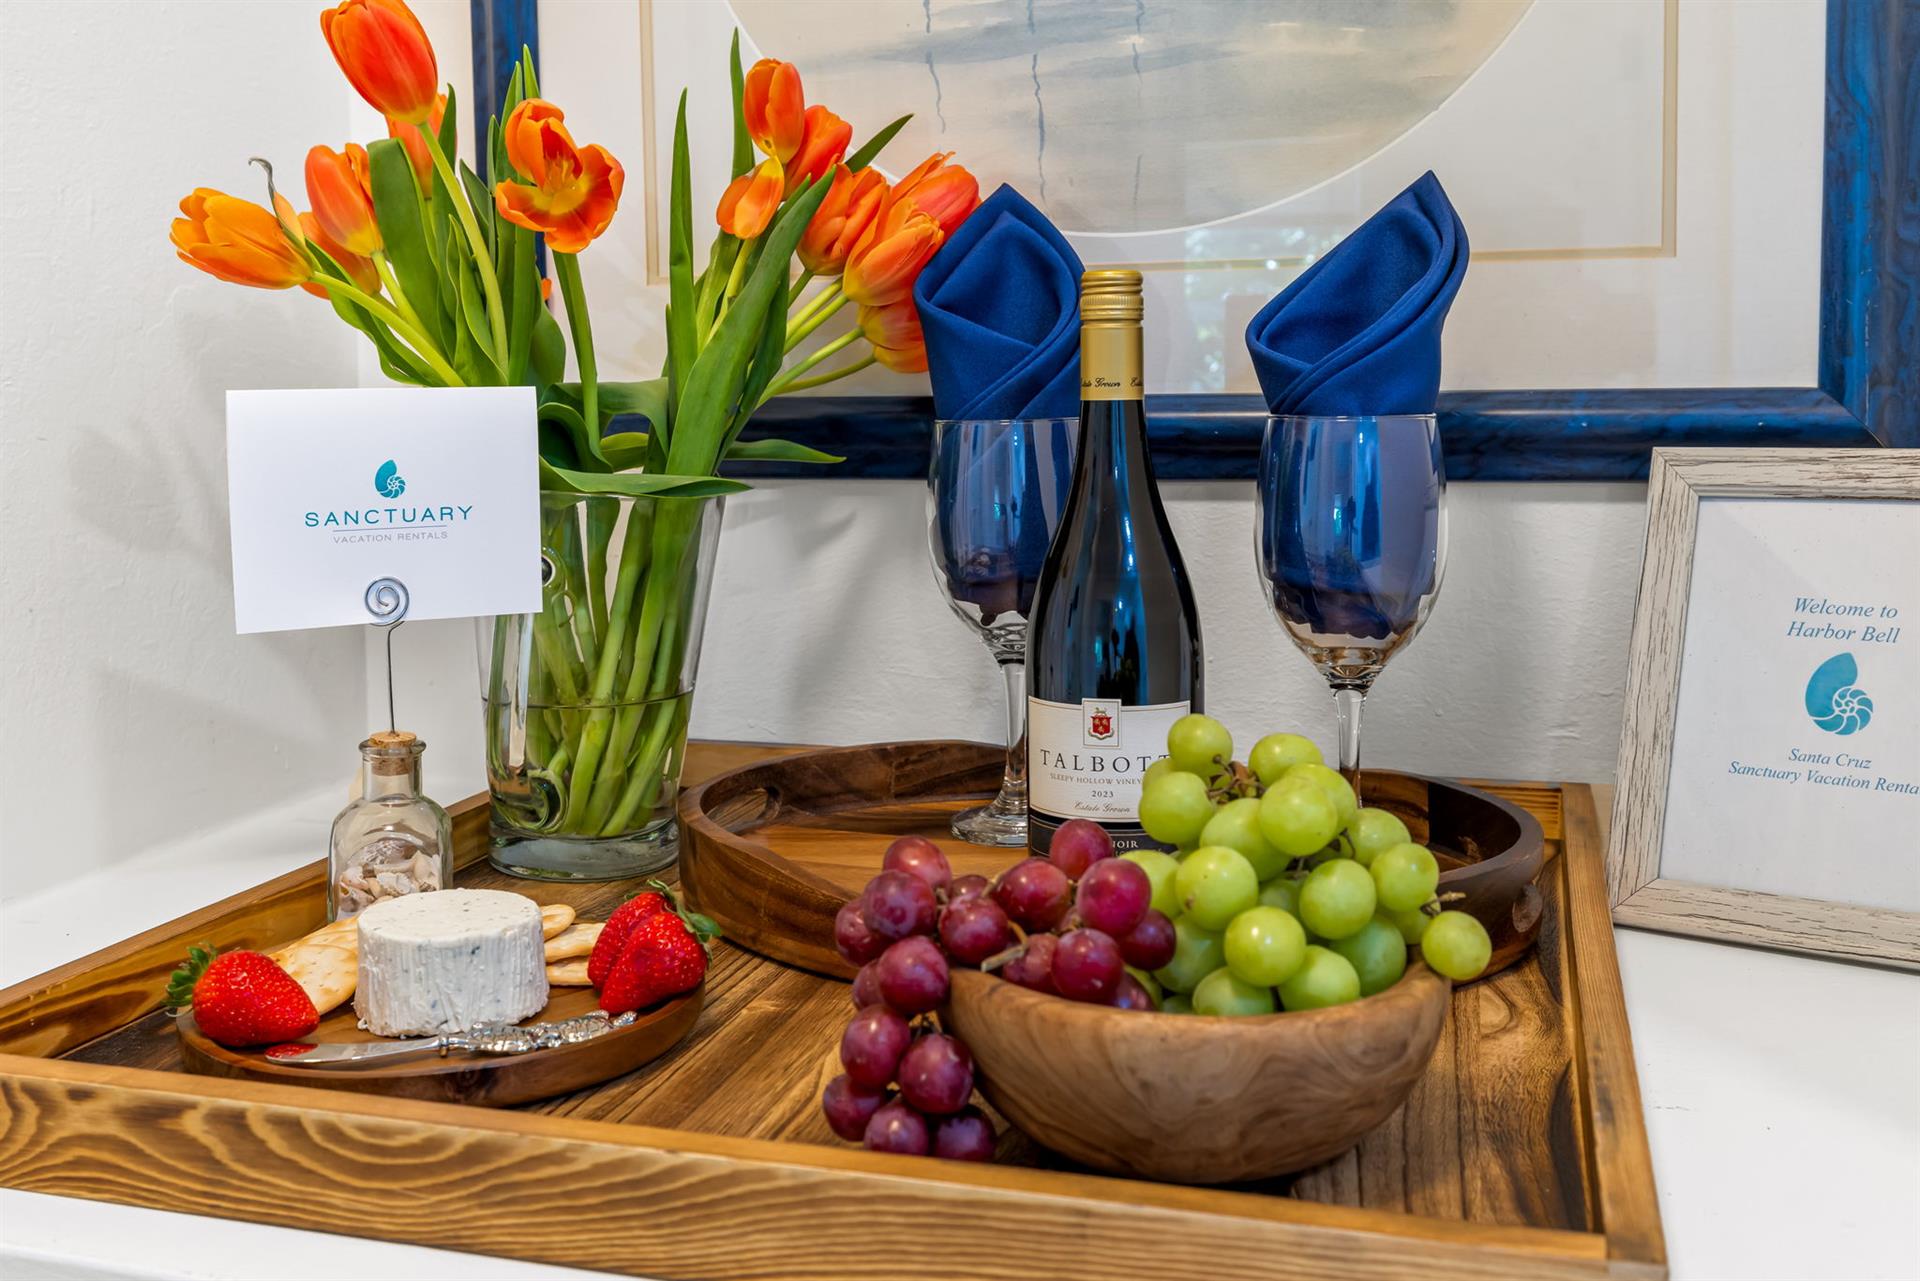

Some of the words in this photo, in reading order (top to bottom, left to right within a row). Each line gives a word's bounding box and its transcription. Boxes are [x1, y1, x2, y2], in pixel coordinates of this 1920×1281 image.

[304, 505, 473, 527] SANCTUARY
[333, 533, 393, 544] VACATION
[397, 531, 448, 541] RENTALS
[1794, 597, 1875, 618] Welcome
[1879, 605, 1899, 619] to
[1786, 621, 1857, 641] Harbor
[1861, 626, 1900, 644] Bell
[1040, 749, 1169, 773] TALBOT
[1788, 748, 1831, 765] Santa
[1835, 753, 1872, 769] Cruz
[1050, 773, 1074, 782] SLEEPY
[1076, 777, 1113, 785] HOLLOW
[1728, 760, 1802, 783] Sanctuary
[1806, 769, 1871, 790] Vacation
[1091, 790, 1114, 798] 2023
[1073, 801, 1099, 812] Estate
[1102, 803, 1131, 814] Grown
